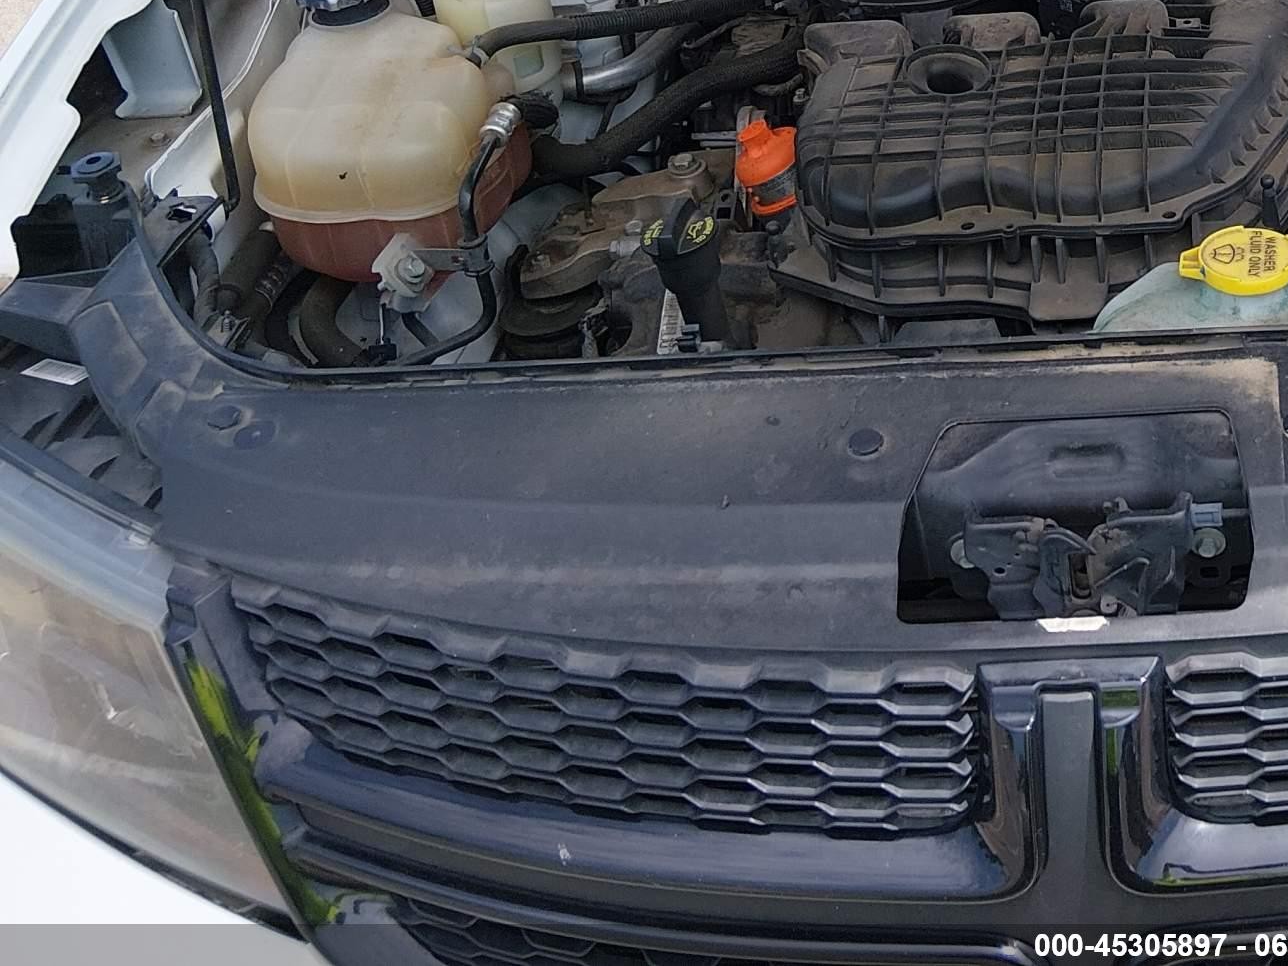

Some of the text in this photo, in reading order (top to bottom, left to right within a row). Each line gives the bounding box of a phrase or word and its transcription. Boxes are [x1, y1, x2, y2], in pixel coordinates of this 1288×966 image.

[1248, 230, 1263, 278] FLUID ONLY
[1264, 237, 1277, 272] WASHER
